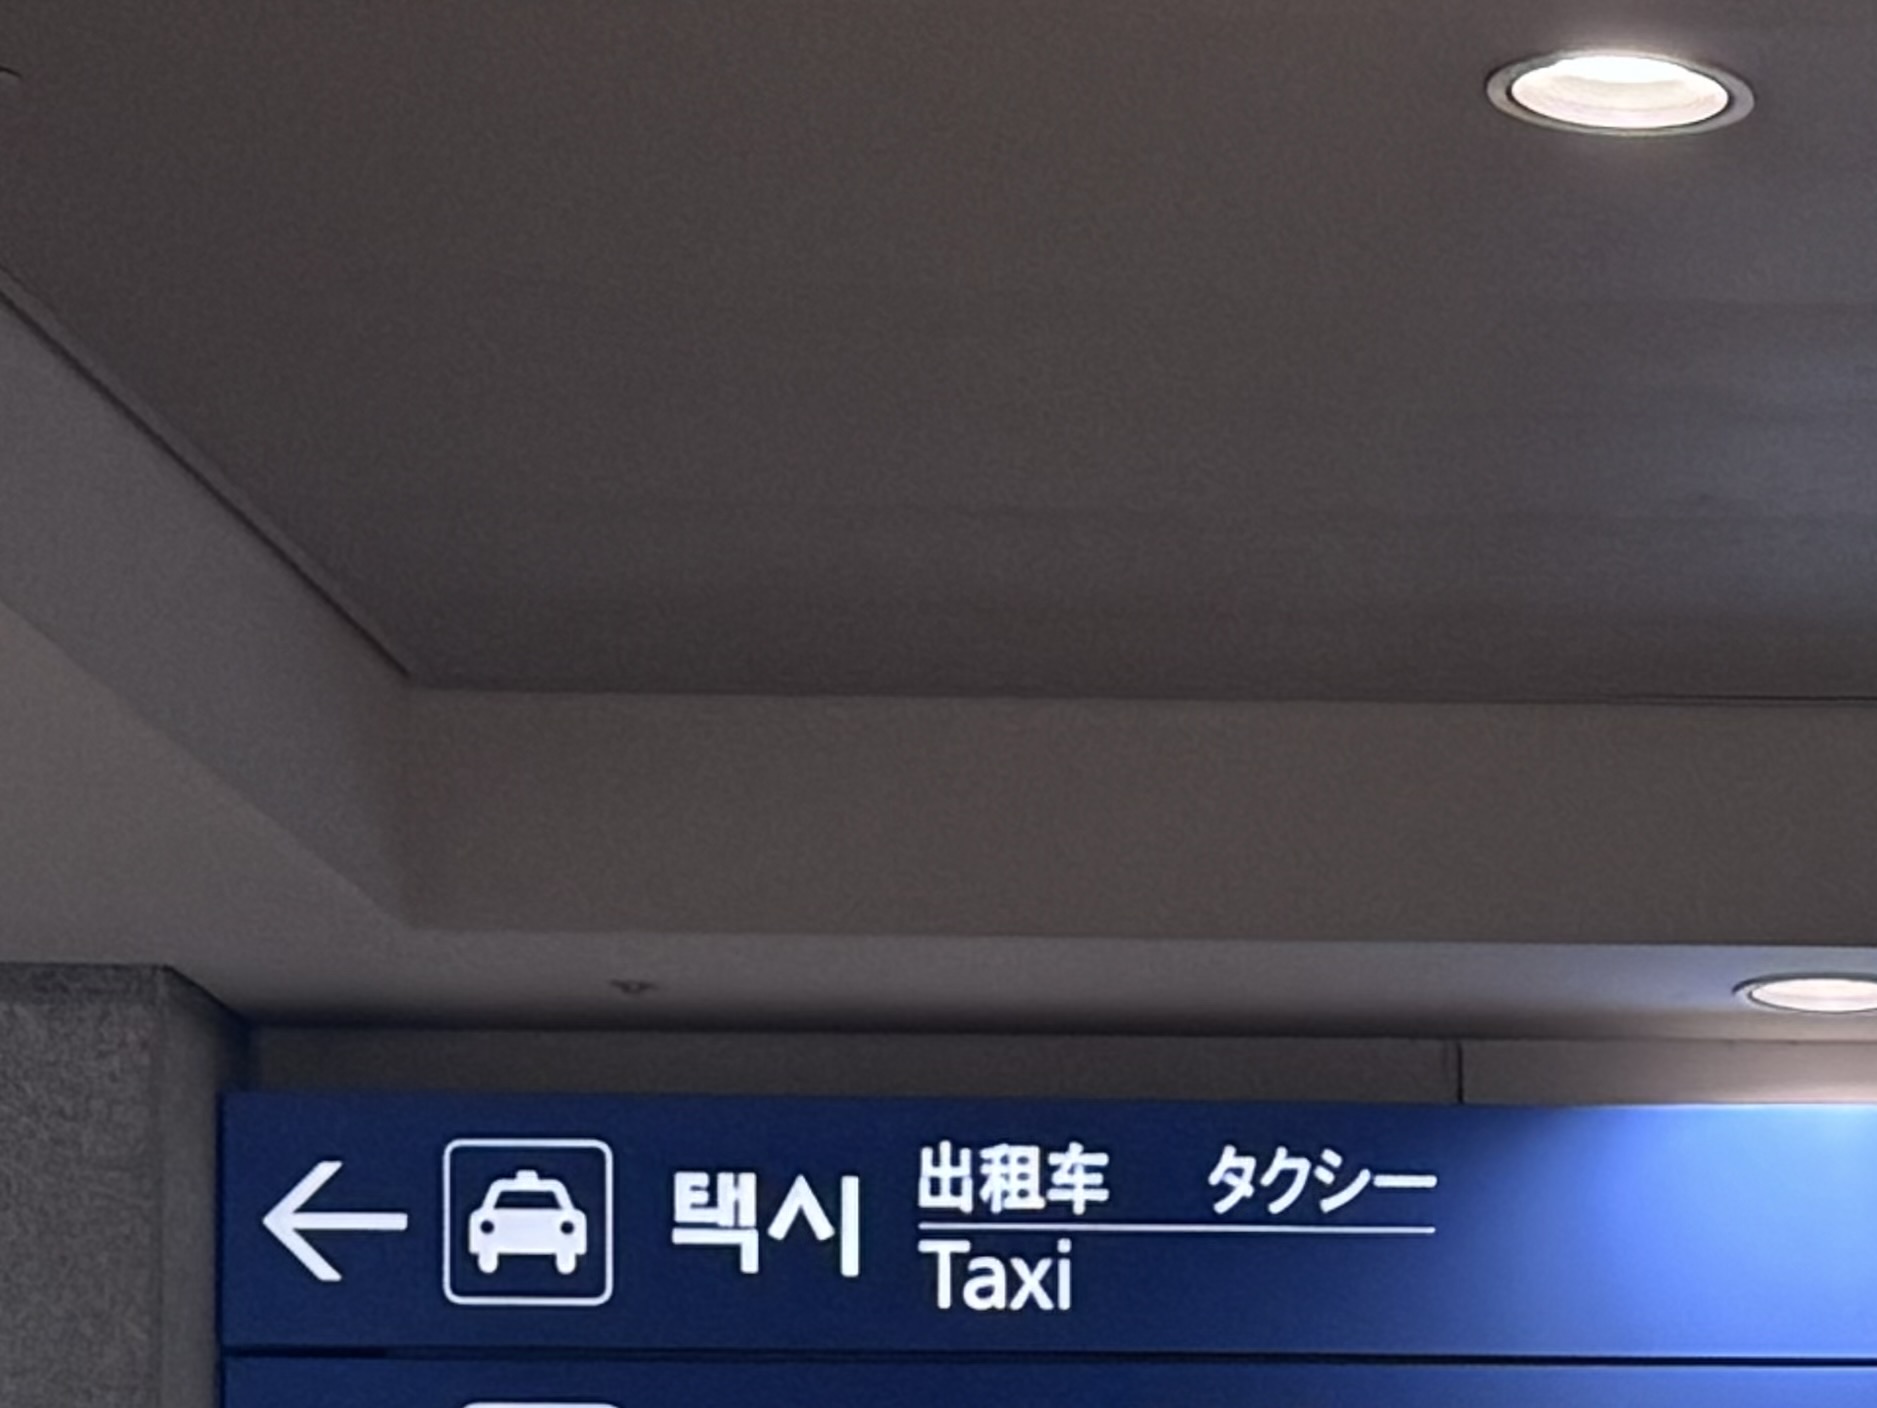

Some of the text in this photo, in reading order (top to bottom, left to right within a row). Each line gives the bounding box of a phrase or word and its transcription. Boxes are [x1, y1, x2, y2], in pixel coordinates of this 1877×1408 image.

[918, 1140, 1109, 1215] 出租车
[1208, 1145, 1438, 1214] タクシー
[671, 1172, 859, 1277] 택시
[918, 1238, 1071, 1311] Taxi
